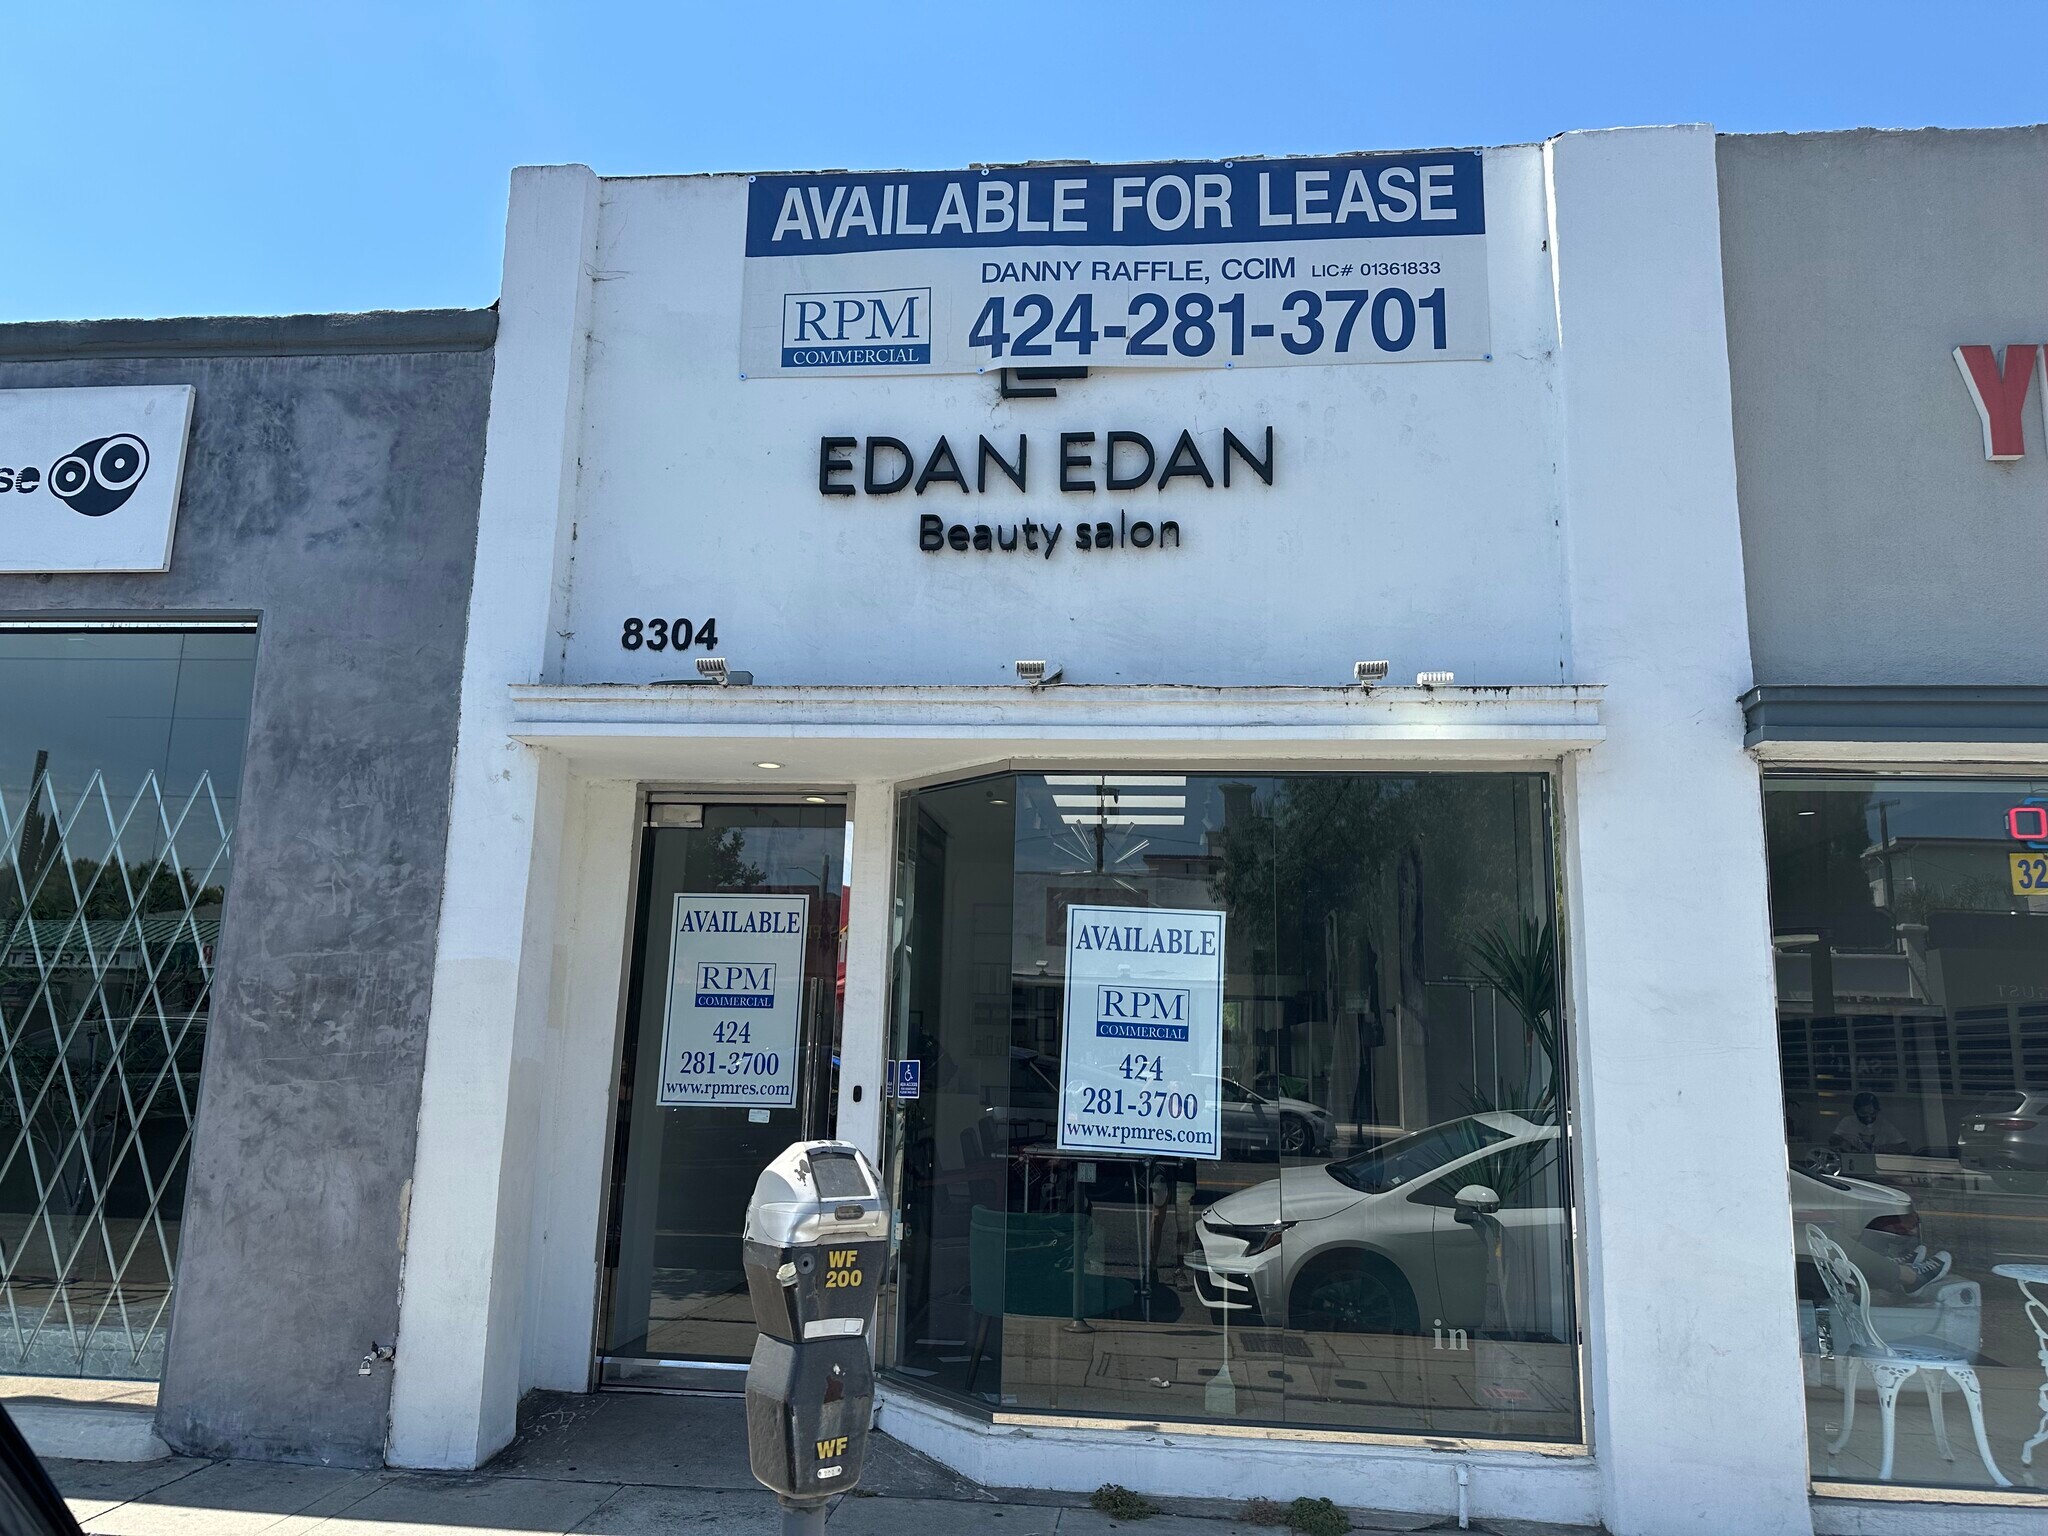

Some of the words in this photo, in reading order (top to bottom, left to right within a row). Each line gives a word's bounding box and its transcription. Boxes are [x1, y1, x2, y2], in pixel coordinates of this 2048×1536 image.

[771, 179, 1088, 241] AVAILABLE
[1113, 174, 1233, 232] FOR
[1259, 165, 1457, 226] LEASE
[981, 261, 1082, 283] DANNY
[1091, 258, 1210, 285] RAFFLE,
[1221, 256, 1295, 280] CCIM
[1312, 263, 1353, 277] LIC#
[1360, 261, 1441, 276] 01361833
[794, 296, 920, 342] RPM
[968, 287, 1447, 359] 424-281-3701
[793, 348, 919, 365] COMMERCIAL
[1952, 343, 2048, 461] Y
[818, 433, 1028, 496] EDAN
[1060, 425, 1275, 493] EDAN
[919, 513, 1062, 560] Beauty
[1075, 508, 1180, 549] salon
[621, 617, 718, 652] 8304
[680, 910, 800, 934] AVAILABLE
[1075, 924, 1216, 956] AVAILABLE
[701, 966, 772, 991] RPM
[698, 996, 772, 1008] COMMERCIAL
[1102, 990, 1186, 1021] RPM
[712, 1020, 751, 1045] 424
[1100, 1024, 1186, 1040] COMMERCIAL
[679, 1051, 779, 1076] 281-3700
[1119, 1053, 1163, 1082] 424
[666, 1081, 789, 1099] www.rpmres.com
[1082, 1087, 1198, 1120] 281-3700
[1066, 1122, 1213, 1145] www.rpmres.com
[829, 1251, 858, 1268] WF
[825, 1270, 862, 1289] 200
[1433, 1319, 1470, 1351] in
[817, 1437, 848, 1459] WF
